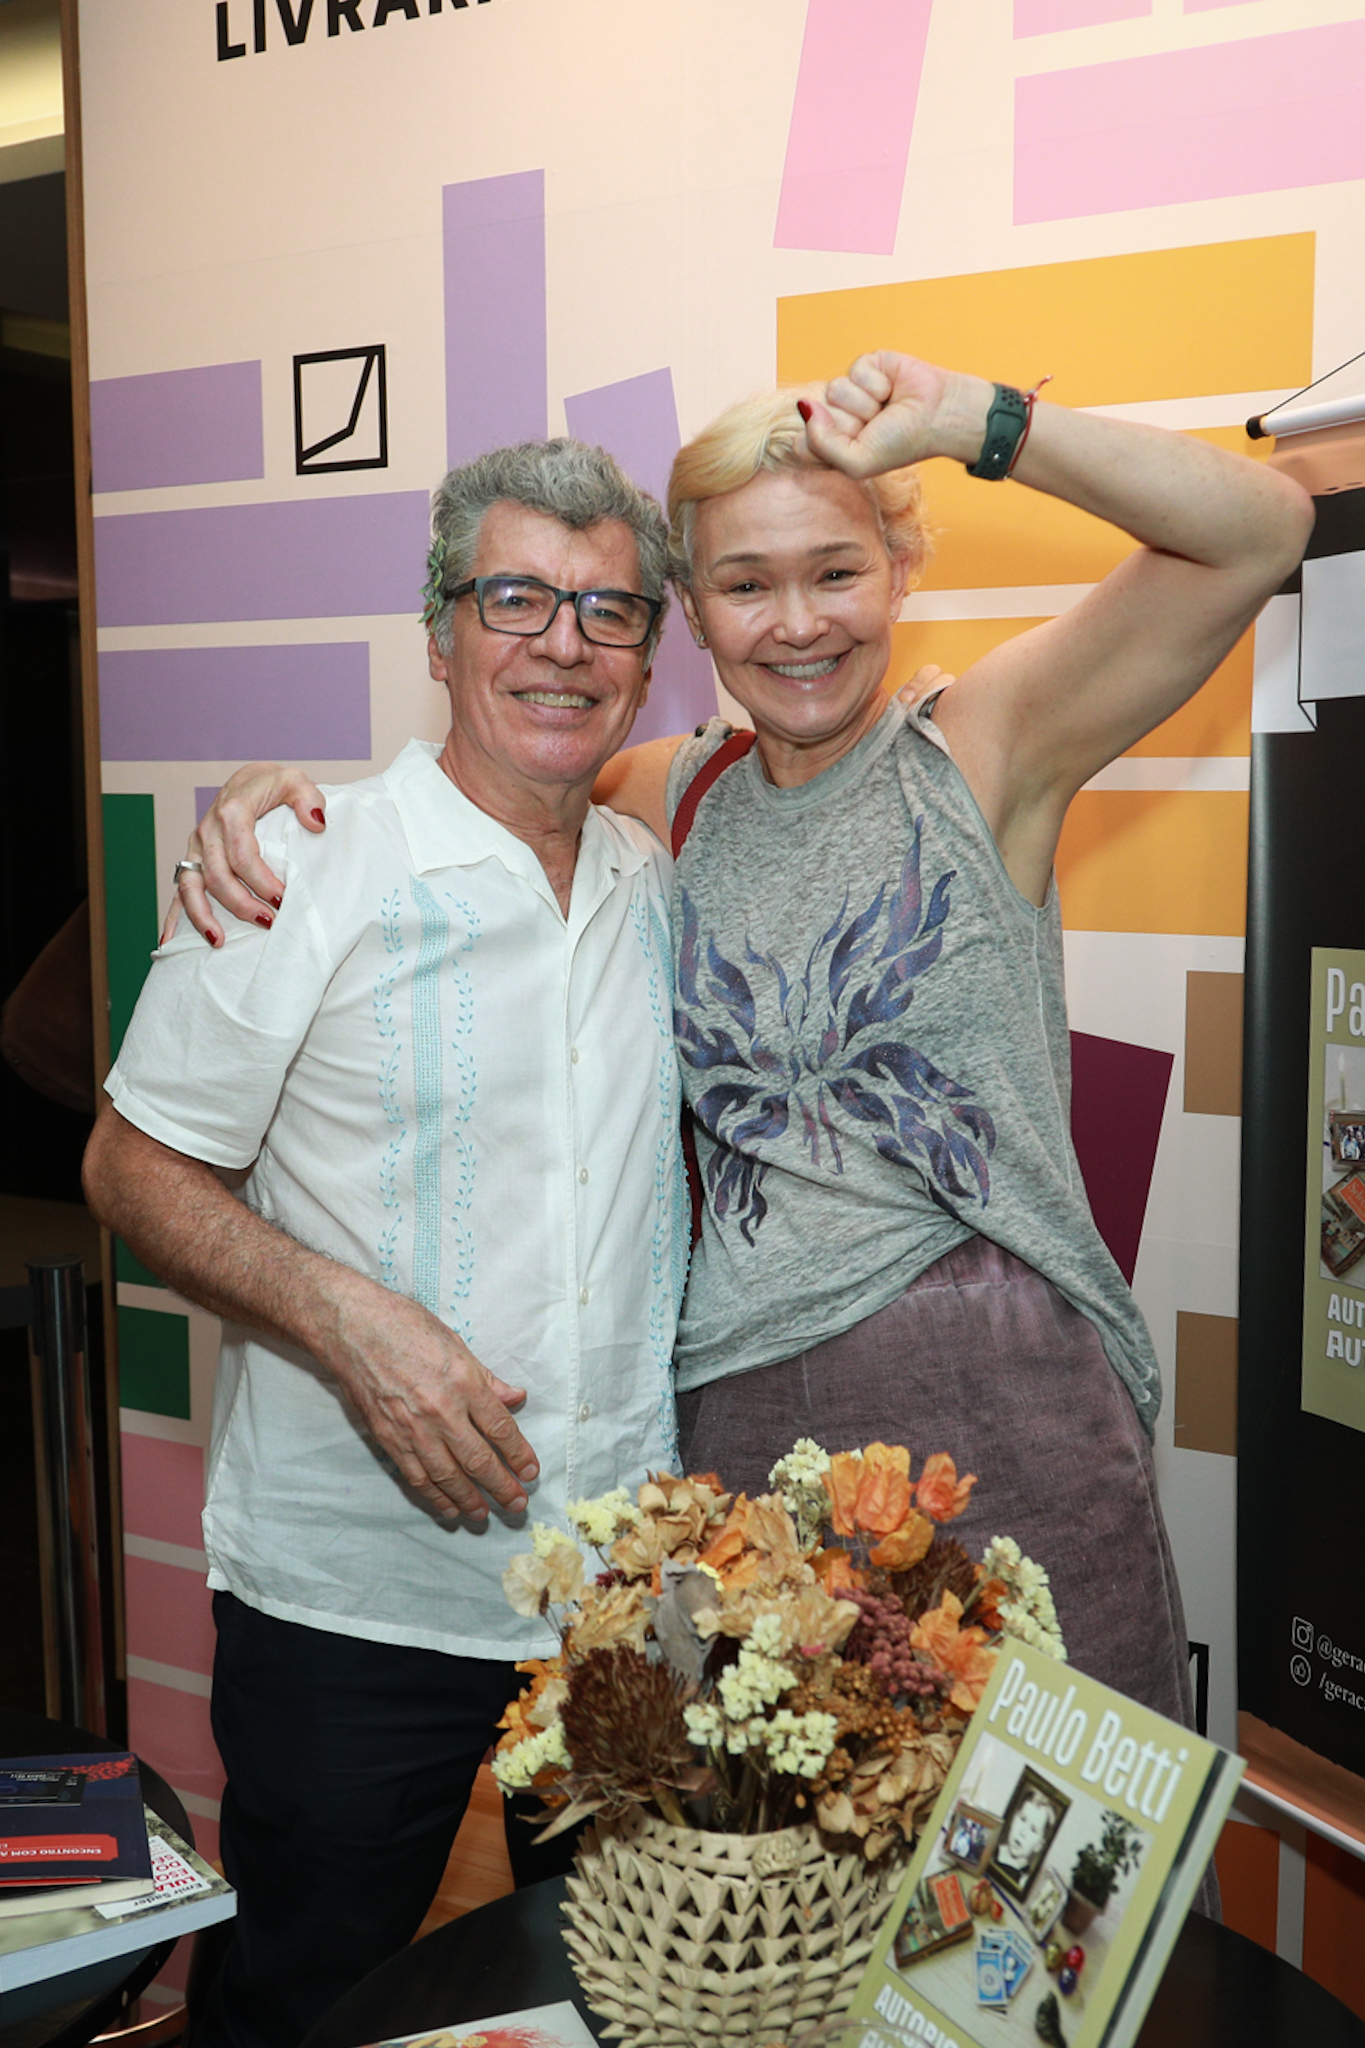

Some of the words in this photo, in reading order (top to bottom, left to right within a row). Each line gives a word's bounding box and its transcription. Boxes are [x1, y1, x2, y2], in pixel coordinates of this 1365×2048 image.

[1317, 1634, 1365, 1674] @gera
[1318, 1671, 1365, 1712] /gerac
[987, 1657, 1089, 1767] Paulo
[1079, 1708, 1190, 1824] Betti
[154, 1868, 189, 1884] ESQ
[155, 1876, 196, 1892] LULA
